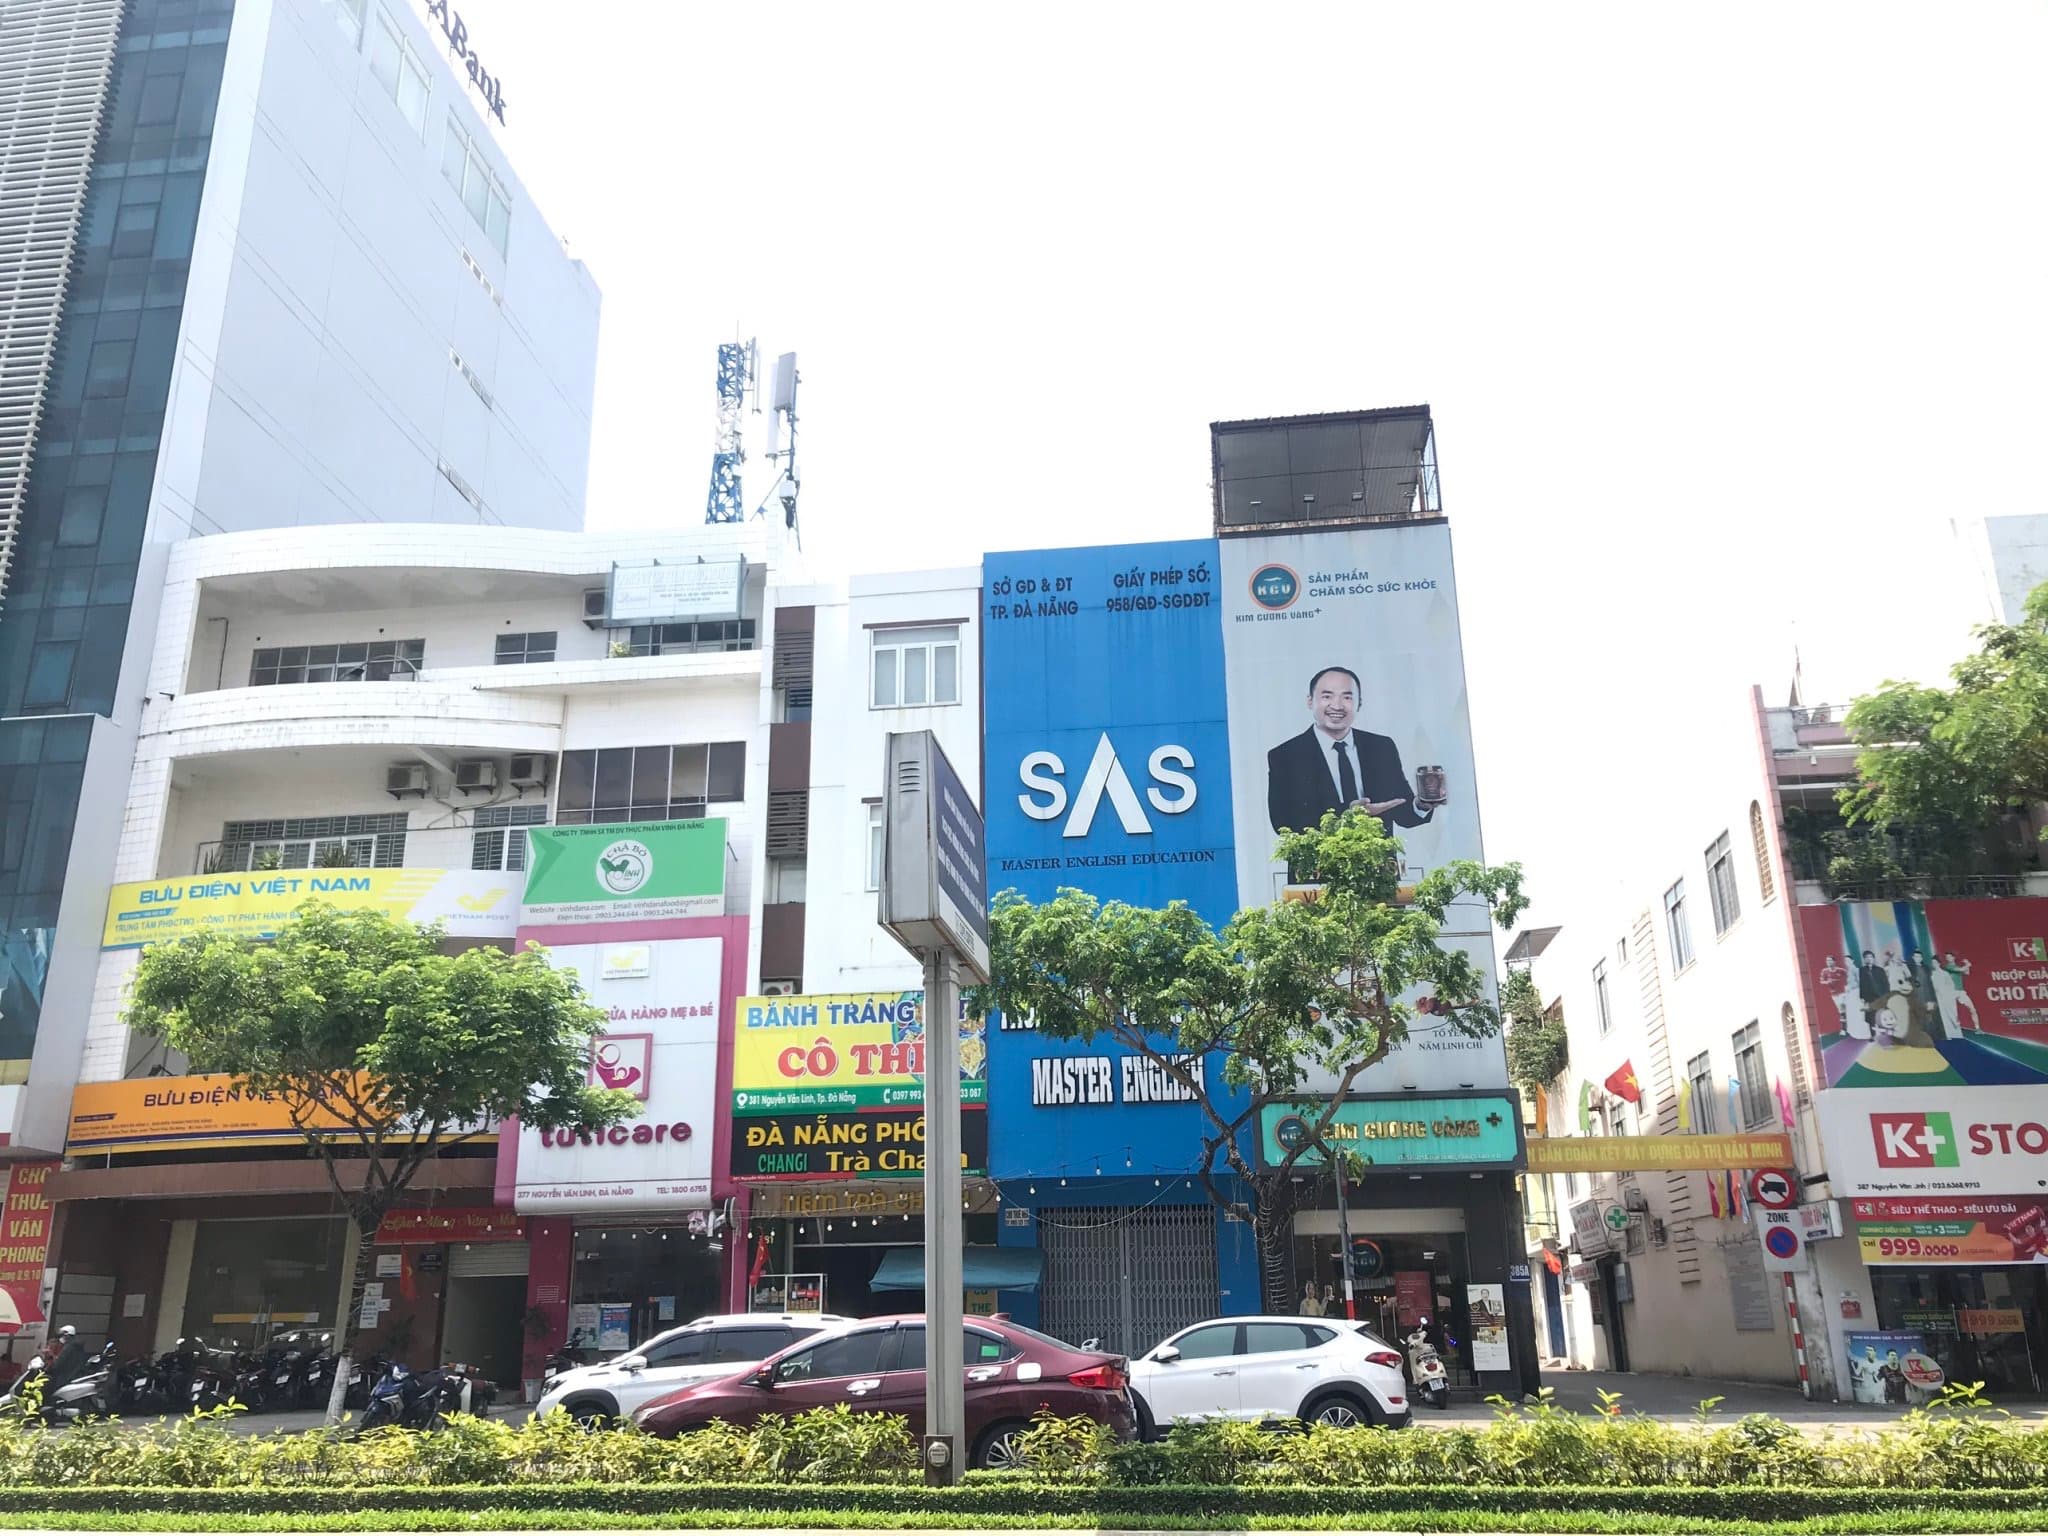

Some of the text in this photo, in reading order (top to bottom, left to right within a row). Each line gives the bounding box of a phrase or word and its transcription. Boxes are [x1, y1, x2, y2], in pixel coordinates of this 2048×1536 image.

[425, 0, 506, 127] ABank
[1113, 560, 1211, 589] GIẤY PHÉP SỐ:
[1308, 567, 1369, 584] SẢN PHẨM
[992, 576, 1073, 596] SỞ GD & ĐT
[1309, 578, 1437, 598] CHĂM SÓC SỨC KHỎE
[990, 595, 1079, 620] TP. ĐÀ NẴNG
[1106, 592, 1211, 614] 958/QĐ-SGDĐT
[1235, 614, 1254, 623] KIM
[1018, 731, 1198, 838] SAS
[580, 828, 597, 836] TNHH
[661, 824, 677, 832] VINH
[1001, 850, 1216, 872] MASTER ENGLISH EDUCATION
[139, 875, 370, 904] BƯU ĐIỆN VIỆT NAM
[530, 906, 555, 914] Website
[2013, 942, 2041, 958] K+
[1987, 986, 2025, 1001] CHO
[631, 1005, 667, 1020] HÀNG
[671, 1006, 687, 1020] MẸ
[689, 1006, 698, 1017] &
[700, 1001, 714, 1017] BÉ
[748, 997, 914, 1028] BÁNH TRÁNG
[1442, 1042, 1465, 1050] LINH
[1466, 1041, 1484, 1050] CHI
[778, 1036, 838, 1078] CÔ
[1032, 1056, 1114, 1105] MASTER
[144, 1089, 185, 1107] BƯU
[190, 1086, 240, 1107] ĐIỆN
[746, 1120, 785, 1147] ĐÀ
[794, 1115, 867, 1146] NẴNG
[1882, 1122, 2048, 1158] K+ STO
[1751, 1142, 1784, 1158] MINH
[758, 1153, 808, 1174] CHANGI
[826, 1149, 870, 1172] Trà
[1766, 1212, 1790, 1223] ZONE
[1891, 1204, 1911, 1215] SIÊU
[1932, 1205, 1957, 1214] THAO
[1964, 1203, 1983, 1214] SIÊU
[10, 1217, 43, 1238] VĂN
[0, 1243, 45, 1264] PHÒNG
[1510, 1264, 1530, 1277] 385A
[971, 1303, 991, 1313] THE
